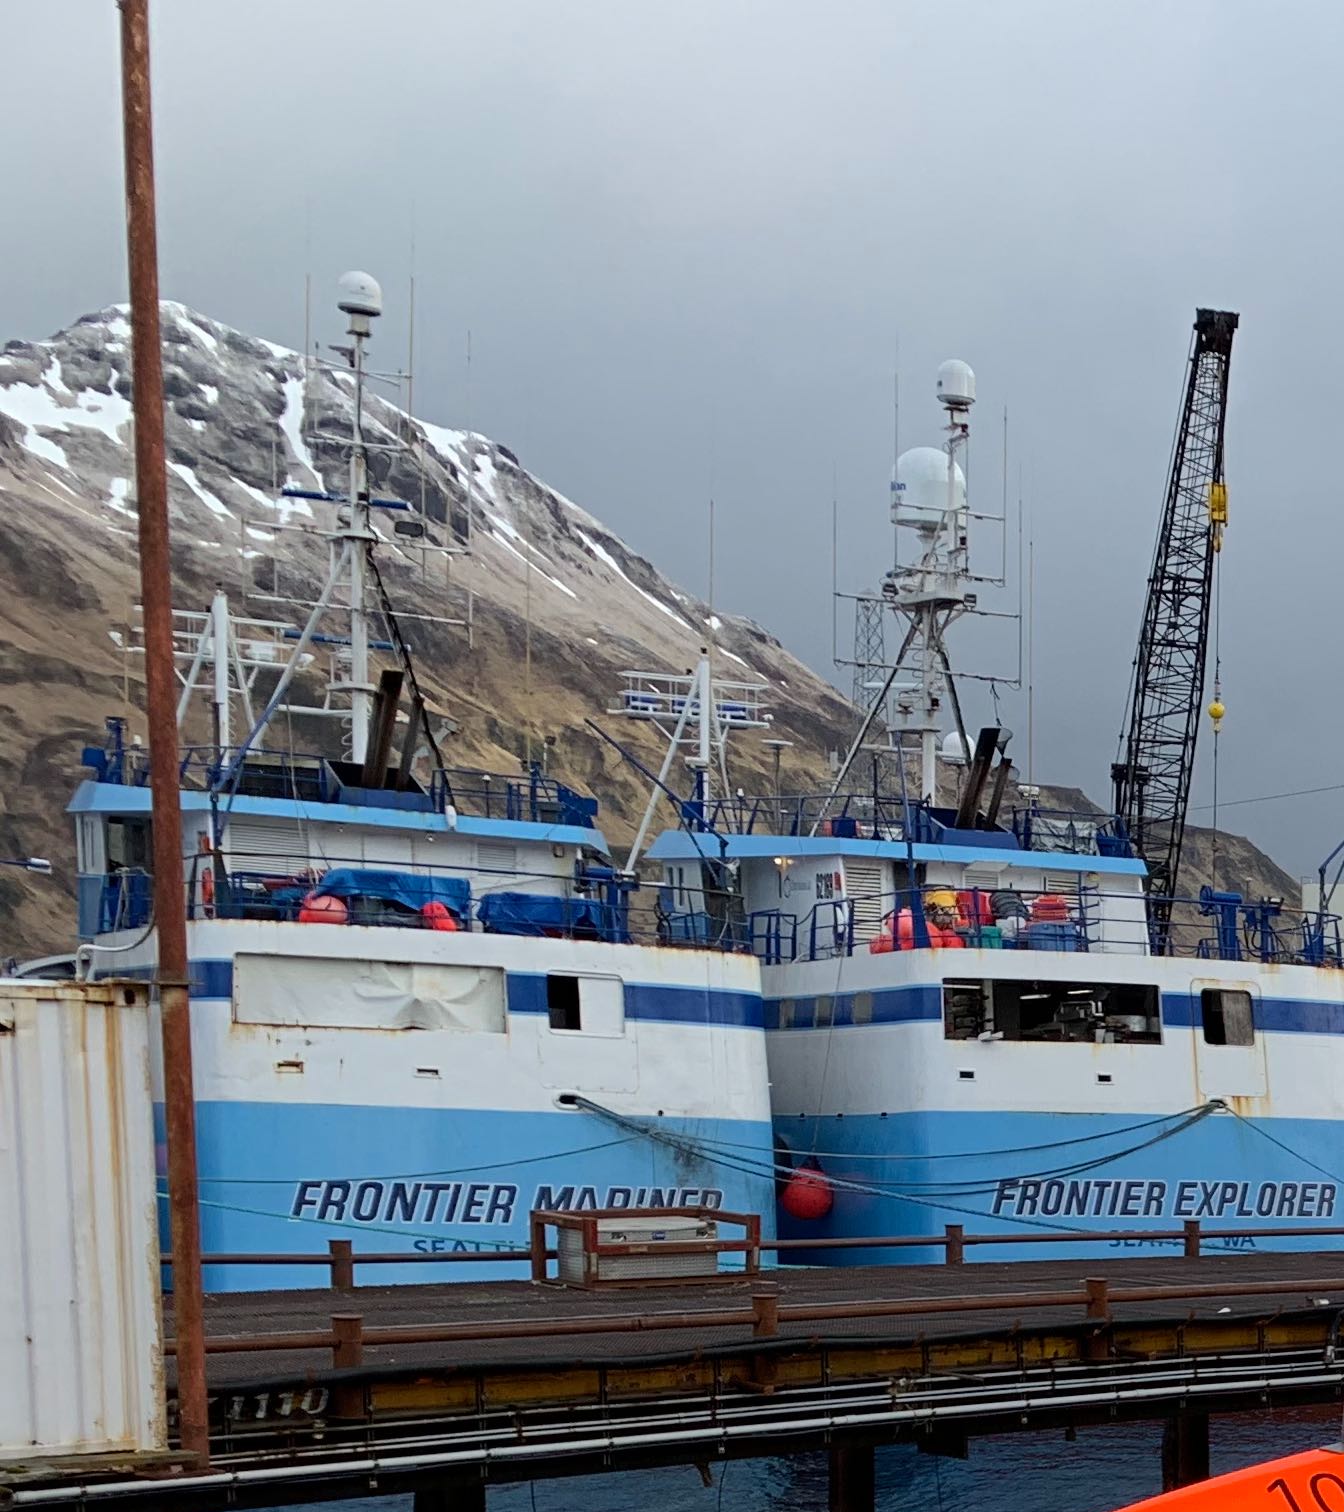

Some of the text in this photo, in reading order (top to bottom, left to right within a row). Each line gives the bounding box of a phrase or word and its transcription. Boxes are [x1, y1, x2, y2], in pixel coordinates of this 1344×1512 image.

[289, 1180, 518, 1225] FRONTIER
[991, 1179, 1337, 1218] FRONTIER EXPLORER
